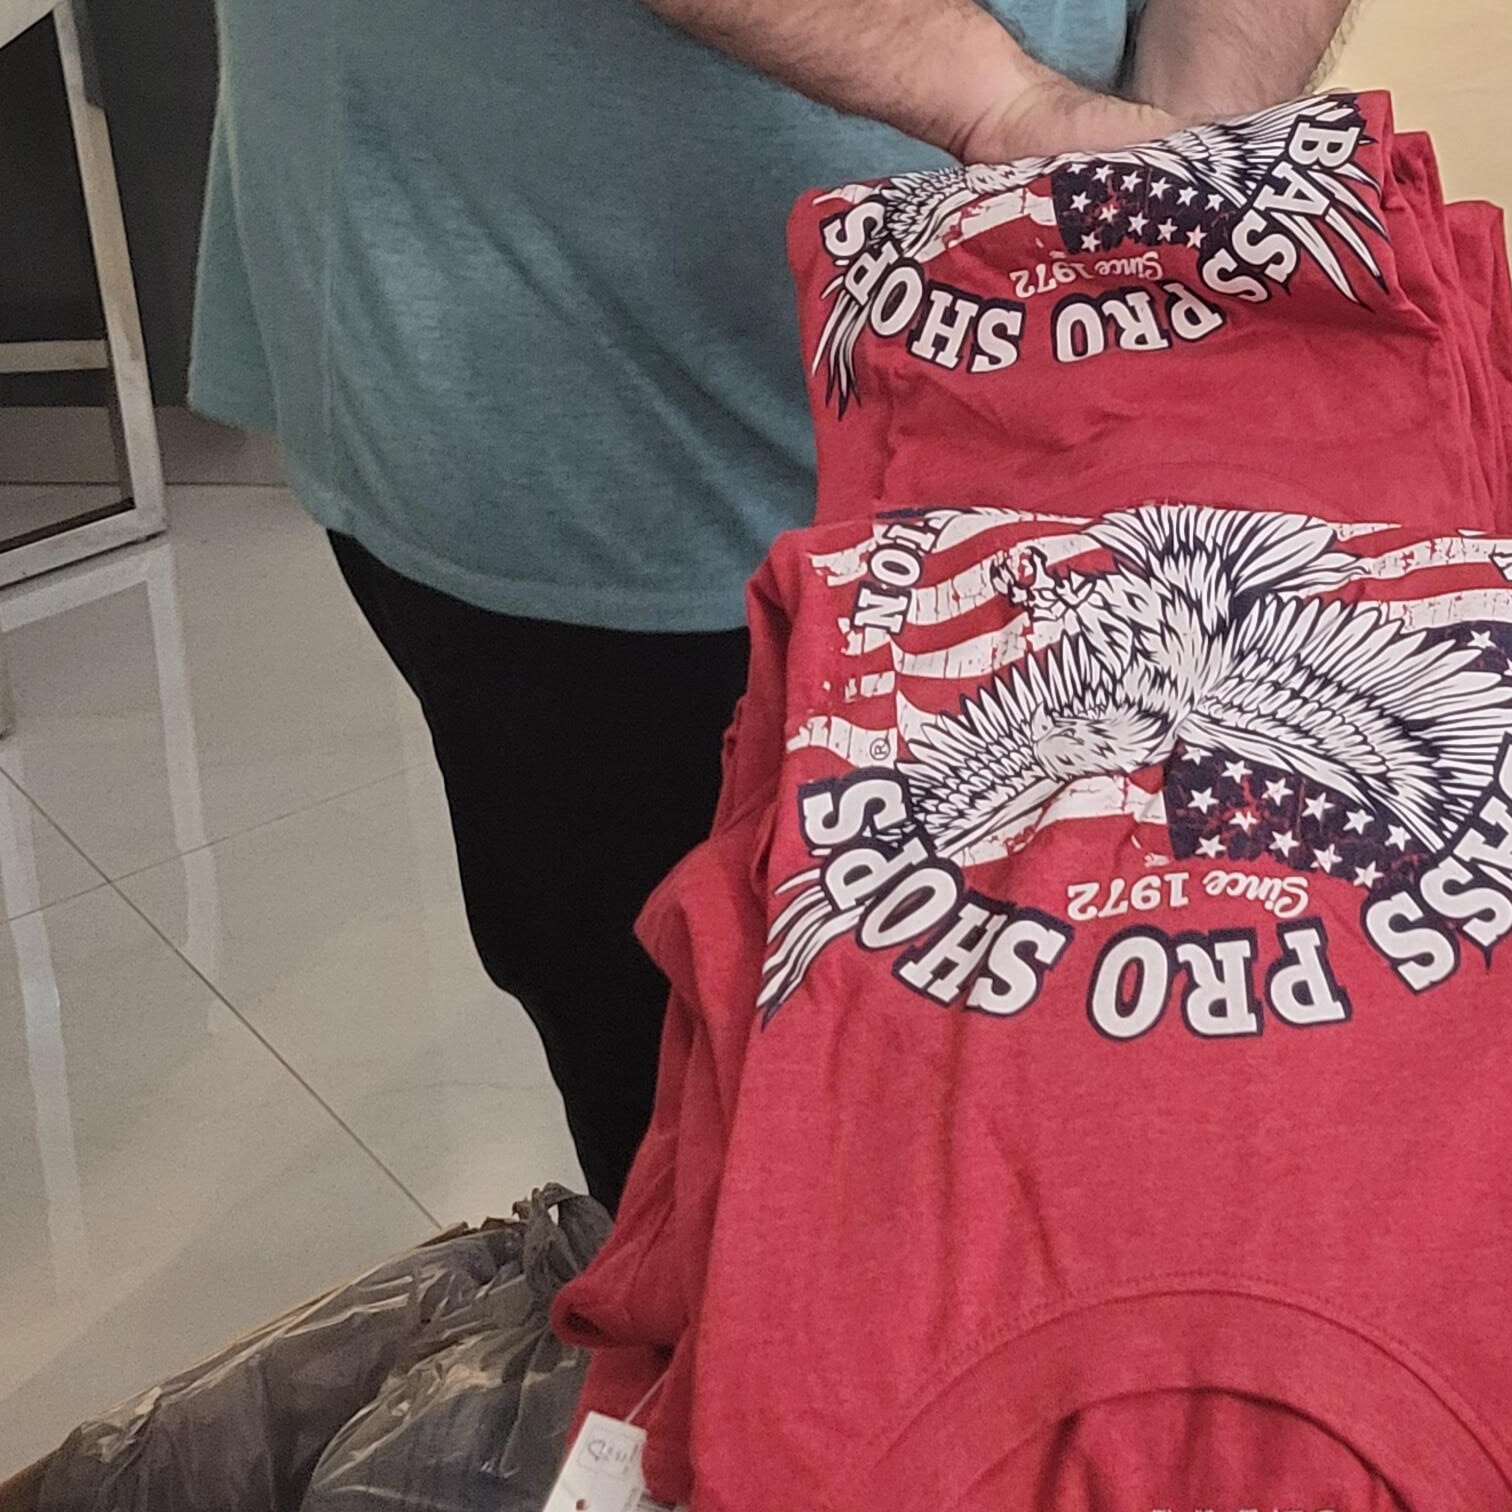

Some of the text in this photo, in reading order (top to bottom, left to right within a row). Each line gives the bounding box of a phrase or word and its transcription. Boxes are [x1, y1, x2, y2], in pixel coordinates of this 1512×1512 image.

[821, 113, 1364, 373] BASS PRO SHOPS
[1010, 250, 1163, 300] Since 1972
[798, 769, 1074, 1016] SHOPS
[1067, 870, 1310, 922] Since 1972
[1089, 918, 1351, 1040] PRO
